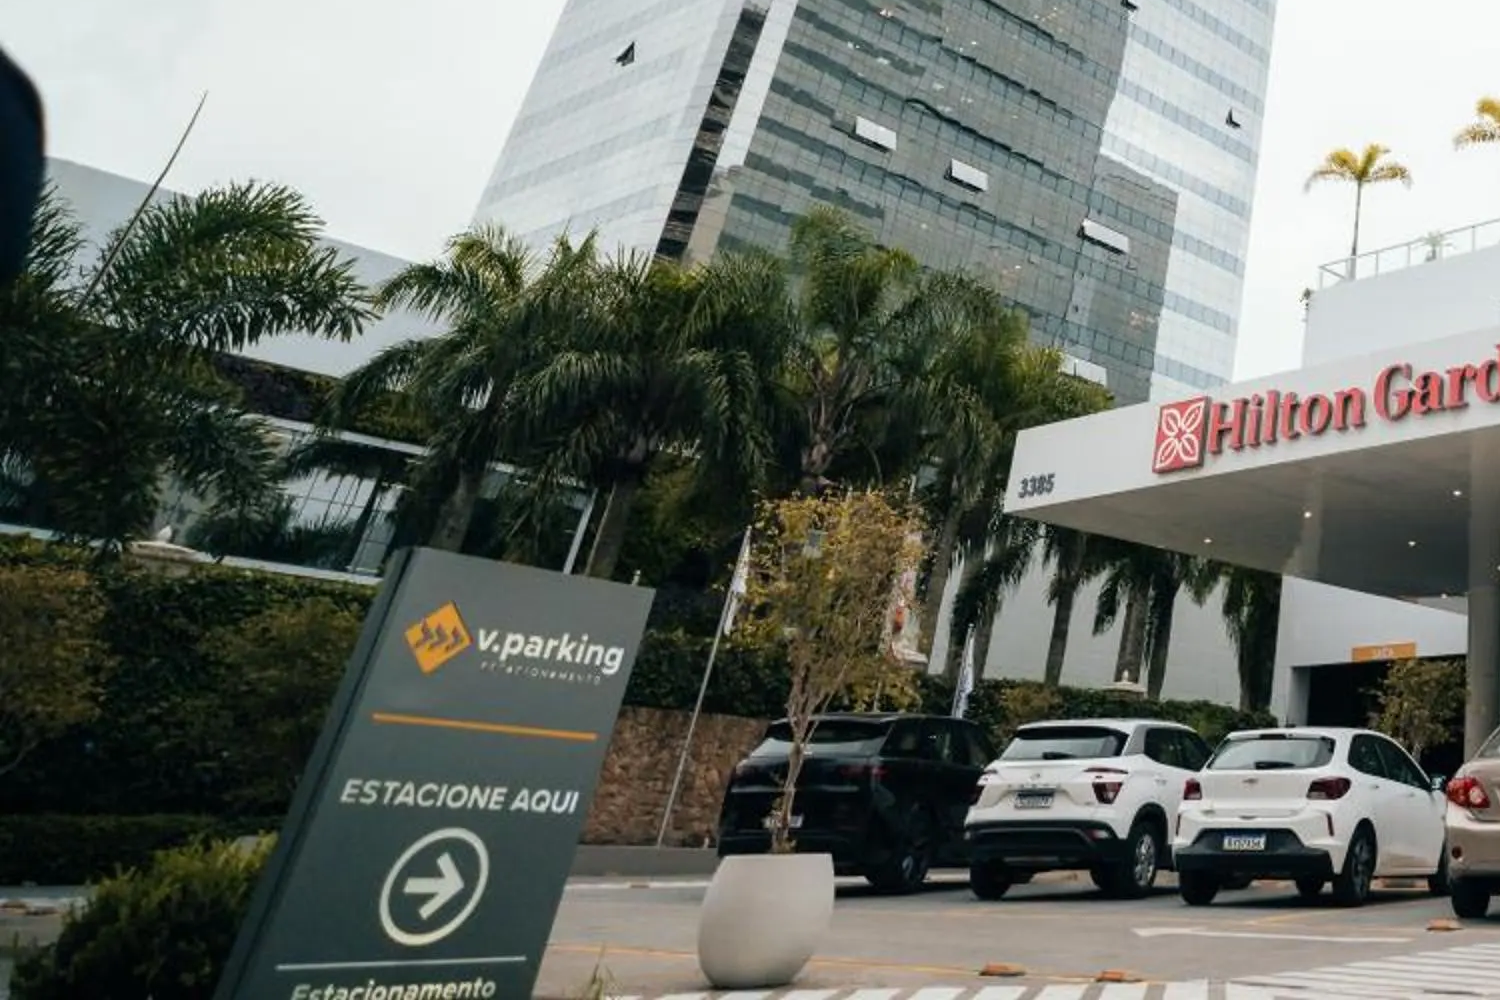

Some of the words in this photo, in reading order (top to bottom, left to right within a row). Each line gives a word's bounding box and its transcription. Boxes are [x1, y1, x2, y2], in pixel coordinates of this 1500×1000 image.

[1208, 383, 1365, 455] Hilton
[1018, 473, 1056, 498] 3385
[478, 628, 625, 675] v.parking
[340, 778, 506, 811] ESTACIONE
[510, 789, 580, 815] AQUI
[290, 976, 497, 1000] Estacionamento
